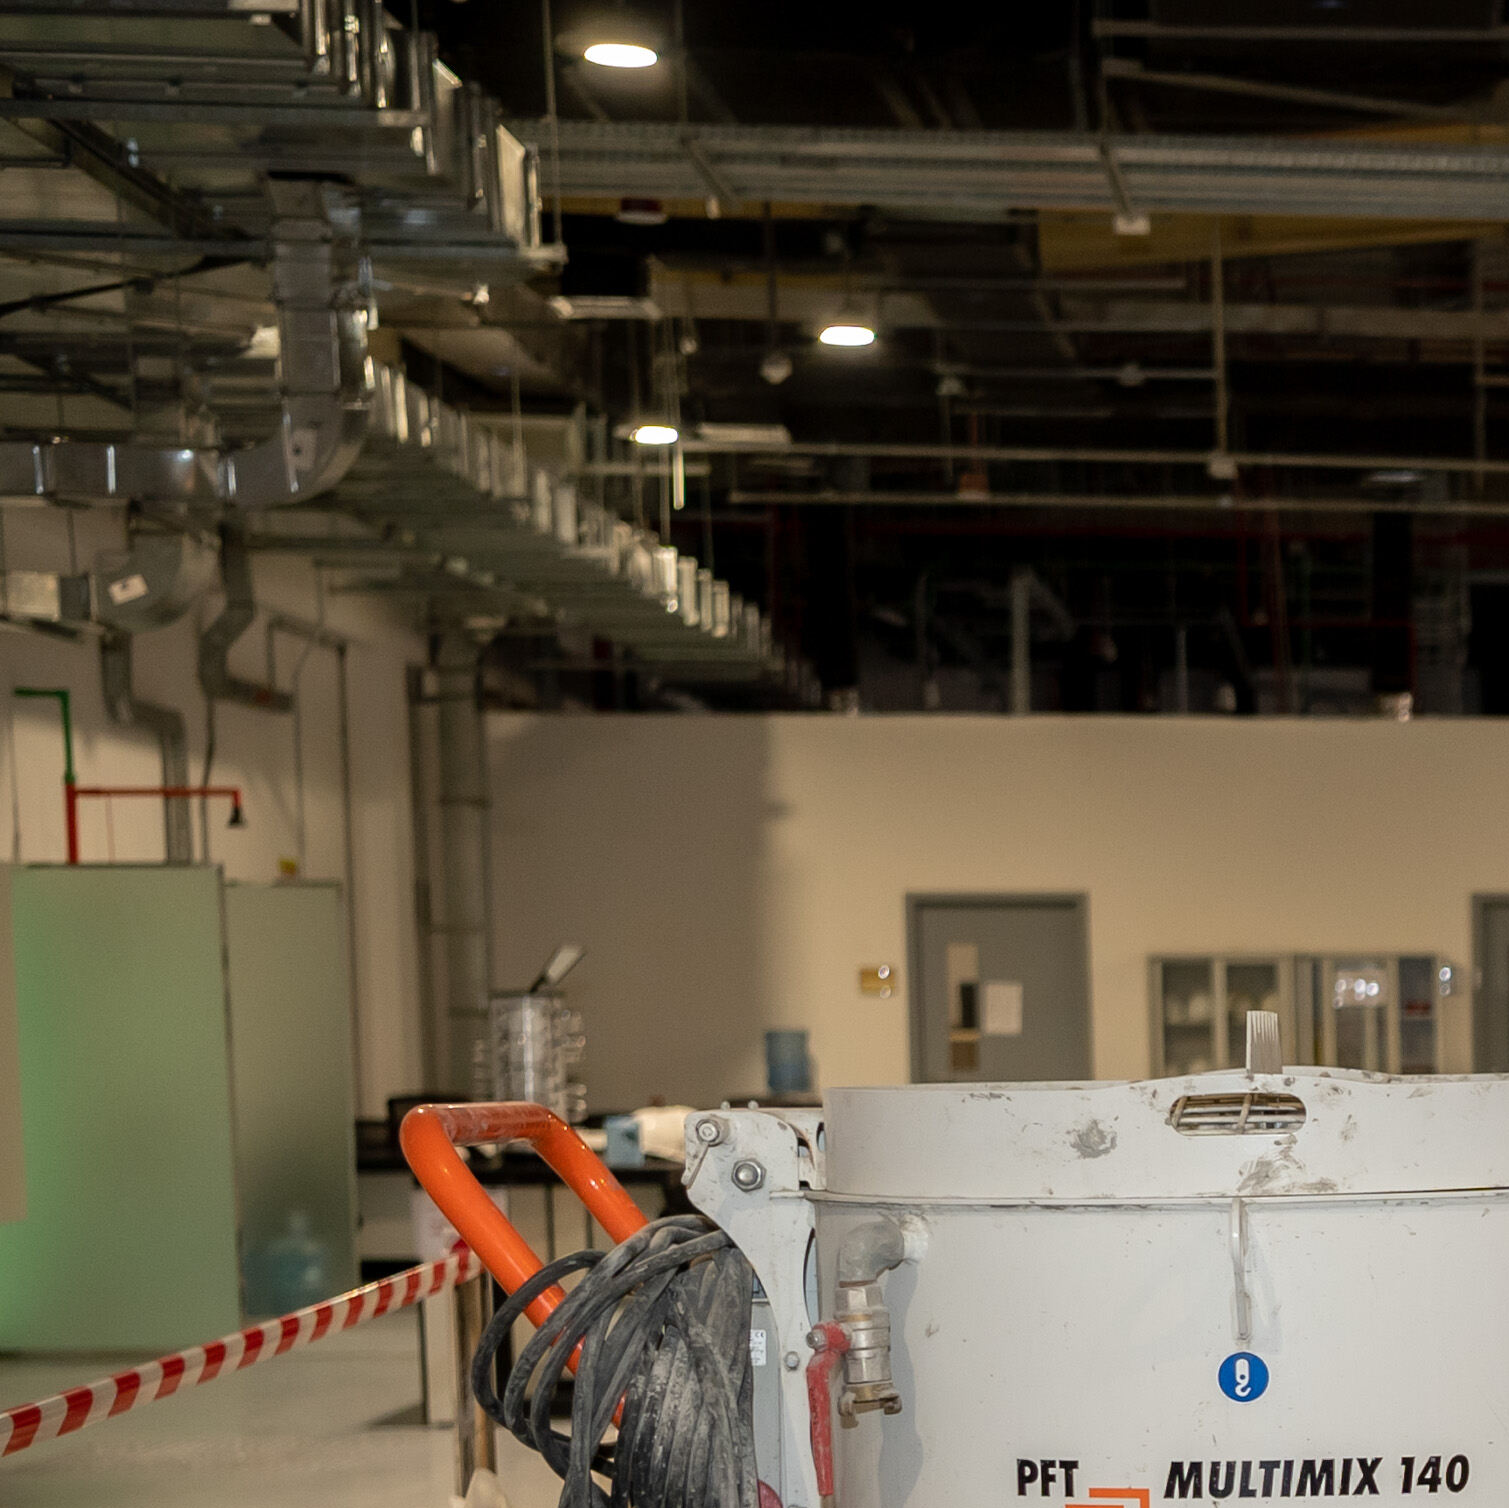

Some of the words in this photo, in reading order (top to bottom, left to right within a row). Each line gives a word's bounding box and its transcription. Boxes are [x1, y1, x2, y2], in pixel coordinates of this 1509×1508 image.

[1016, 1458, 1080, 1498] PFT
[1163, 1456, 1384, 1500] MULTIMIX
[1400, 1454, 1471, 1495] 140
